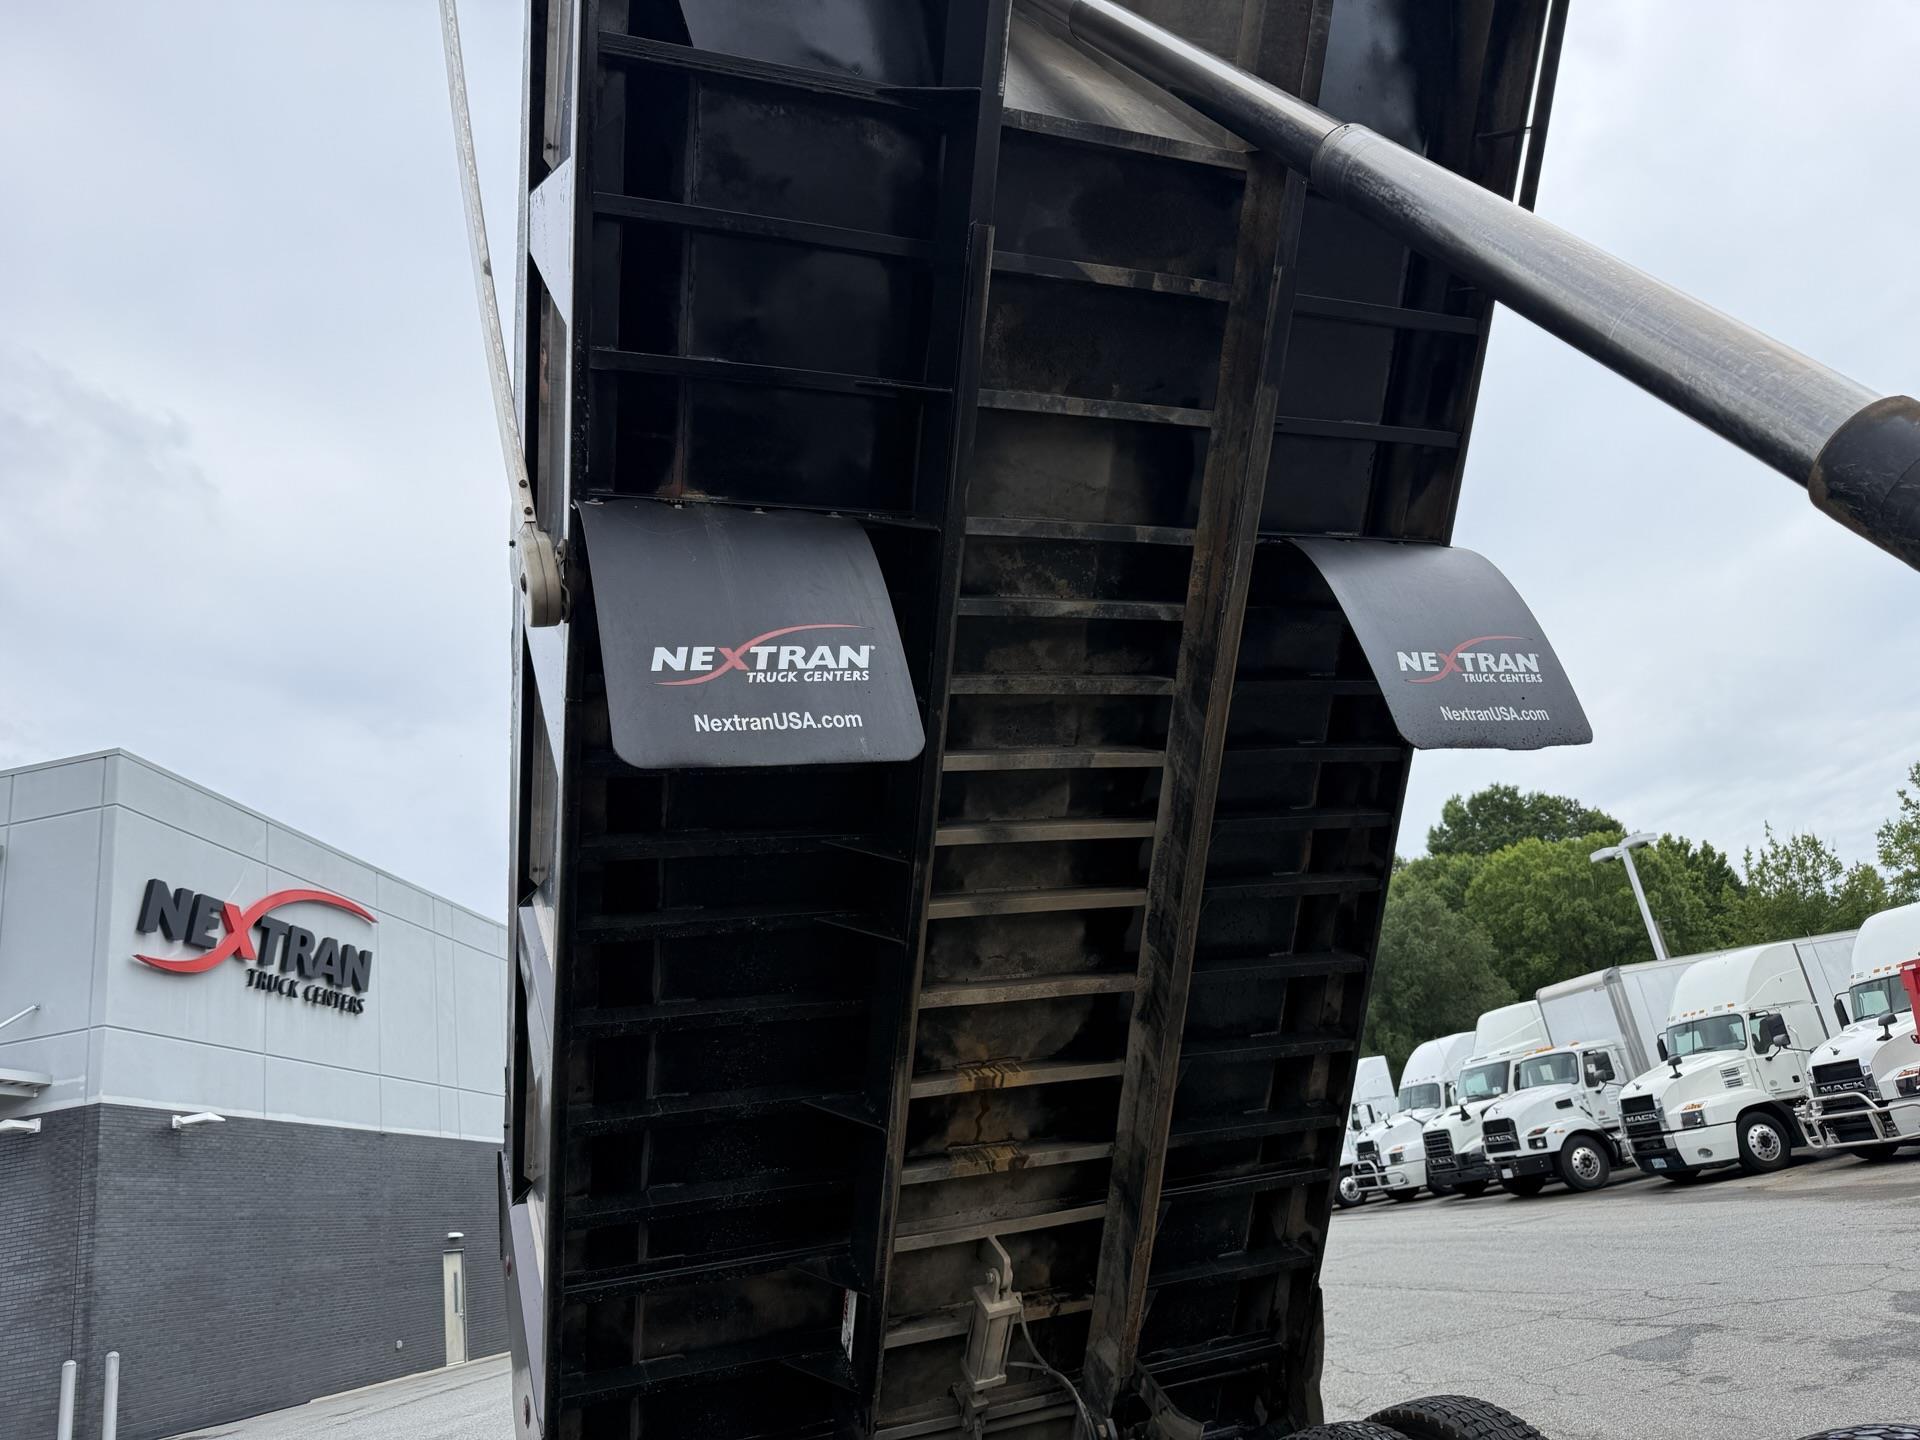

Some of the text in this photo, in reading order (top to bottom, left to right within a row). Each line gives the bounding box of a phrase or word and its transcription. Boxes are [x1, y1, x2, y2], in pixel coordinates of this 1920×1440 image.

[650, 645, 870, 672] NEXTRAN
[1396, 651, 1540, 673] NEXTRAN
[747, 670, 870, 683] TRUCK CENTERS
[1462, 673, 1543, 683] TRUCK CENTERS
[693, 711, 864, 733] NextranUSA.com
[1439, 705, 1550, 722] NextranUSA.com
[136, 878, 373, 993] NEXTRAN
[246, 967, 366, 1015] TRUCK CENTERS
[1820, 1080, 1865, 1093] MACK
[1625, 1113, 1658, 1122] MACK
